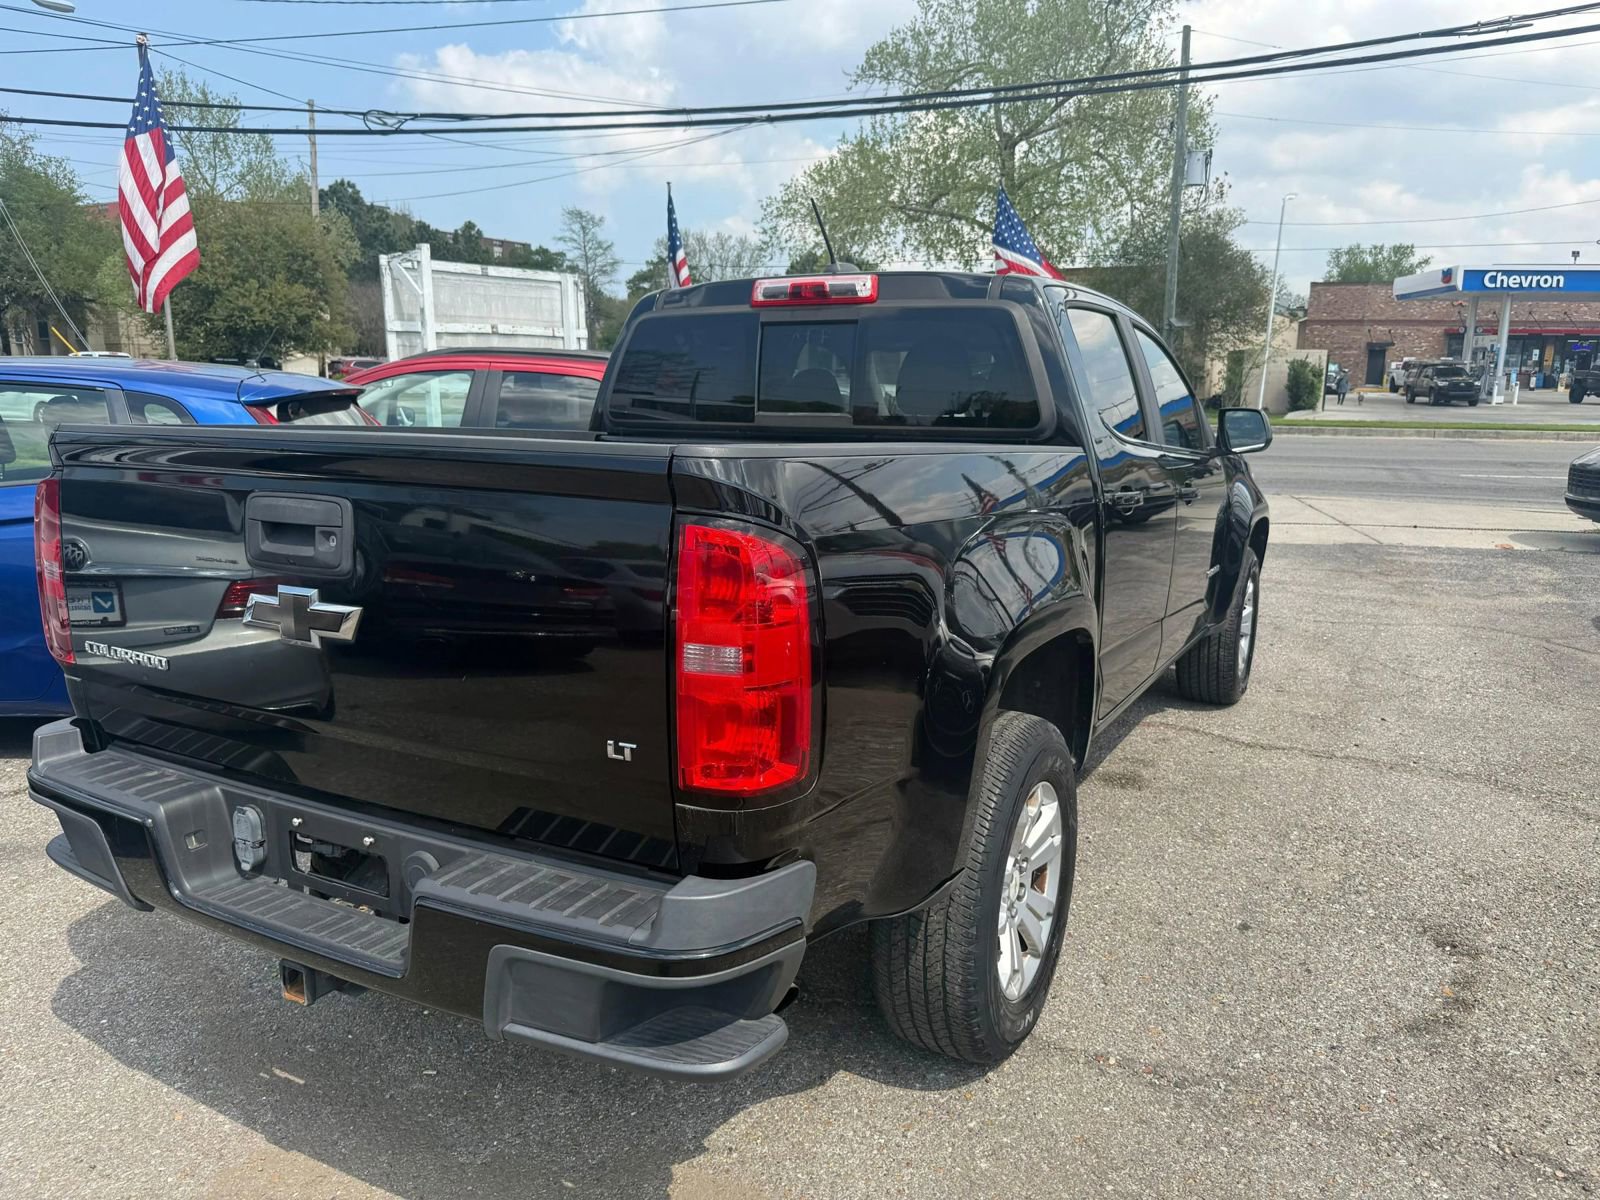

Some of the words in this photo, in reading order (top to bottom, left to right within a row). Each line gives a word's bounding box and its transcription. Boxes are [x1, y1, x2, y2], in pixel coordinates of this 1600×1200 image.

[1483, 271, 1565, 288] Chevron
[84, 640, 169, 671] COLORADO
[607, 740, 637, 762] LT
